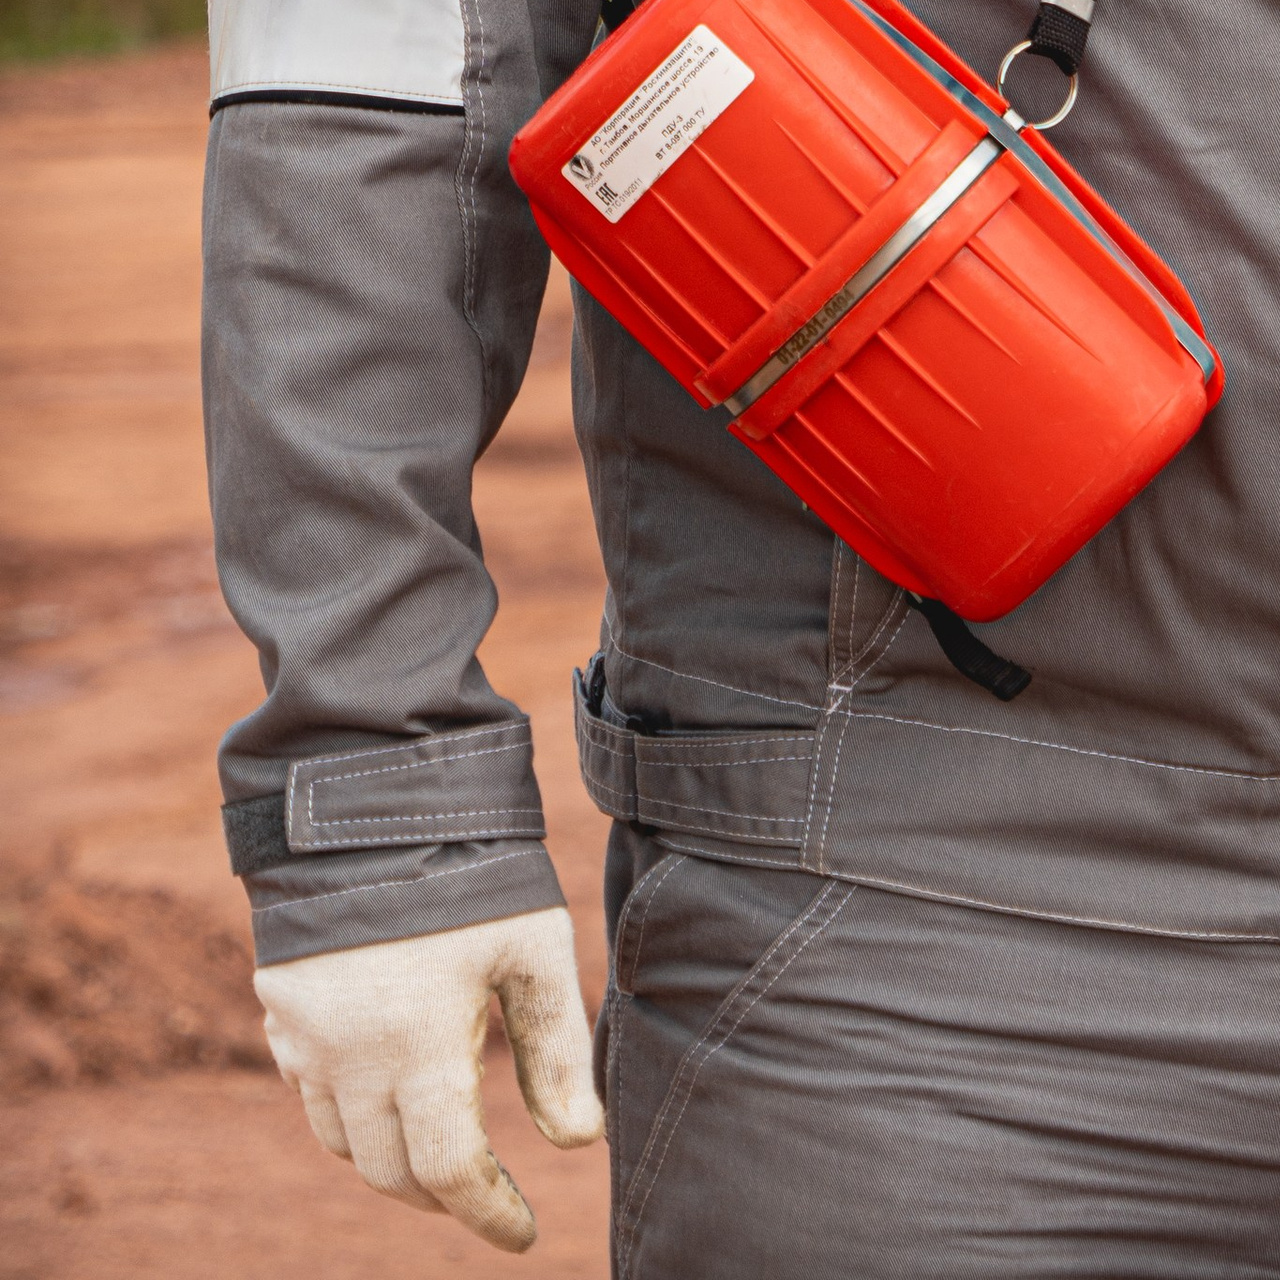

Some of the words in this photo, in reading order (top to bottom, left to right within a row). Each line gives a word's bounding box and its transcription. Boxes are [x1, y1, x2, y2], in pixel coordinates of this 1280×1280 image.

[627, 80, 671, 124] Моршанское
[693, 45, 704, 56] 19
[599, 130, 638, 170] Портативное
[637, 86, 681, 133] дыхательное
[679, 47, 719, 89] устройство
[661, 115, 684, 138] ПДУ-3
[590, 135, 602, 148] АО
[655, 147, 666, 161] ВТ
[694, 106, 705, 119] ТУ
[584, 171, 604, 191] Россия
